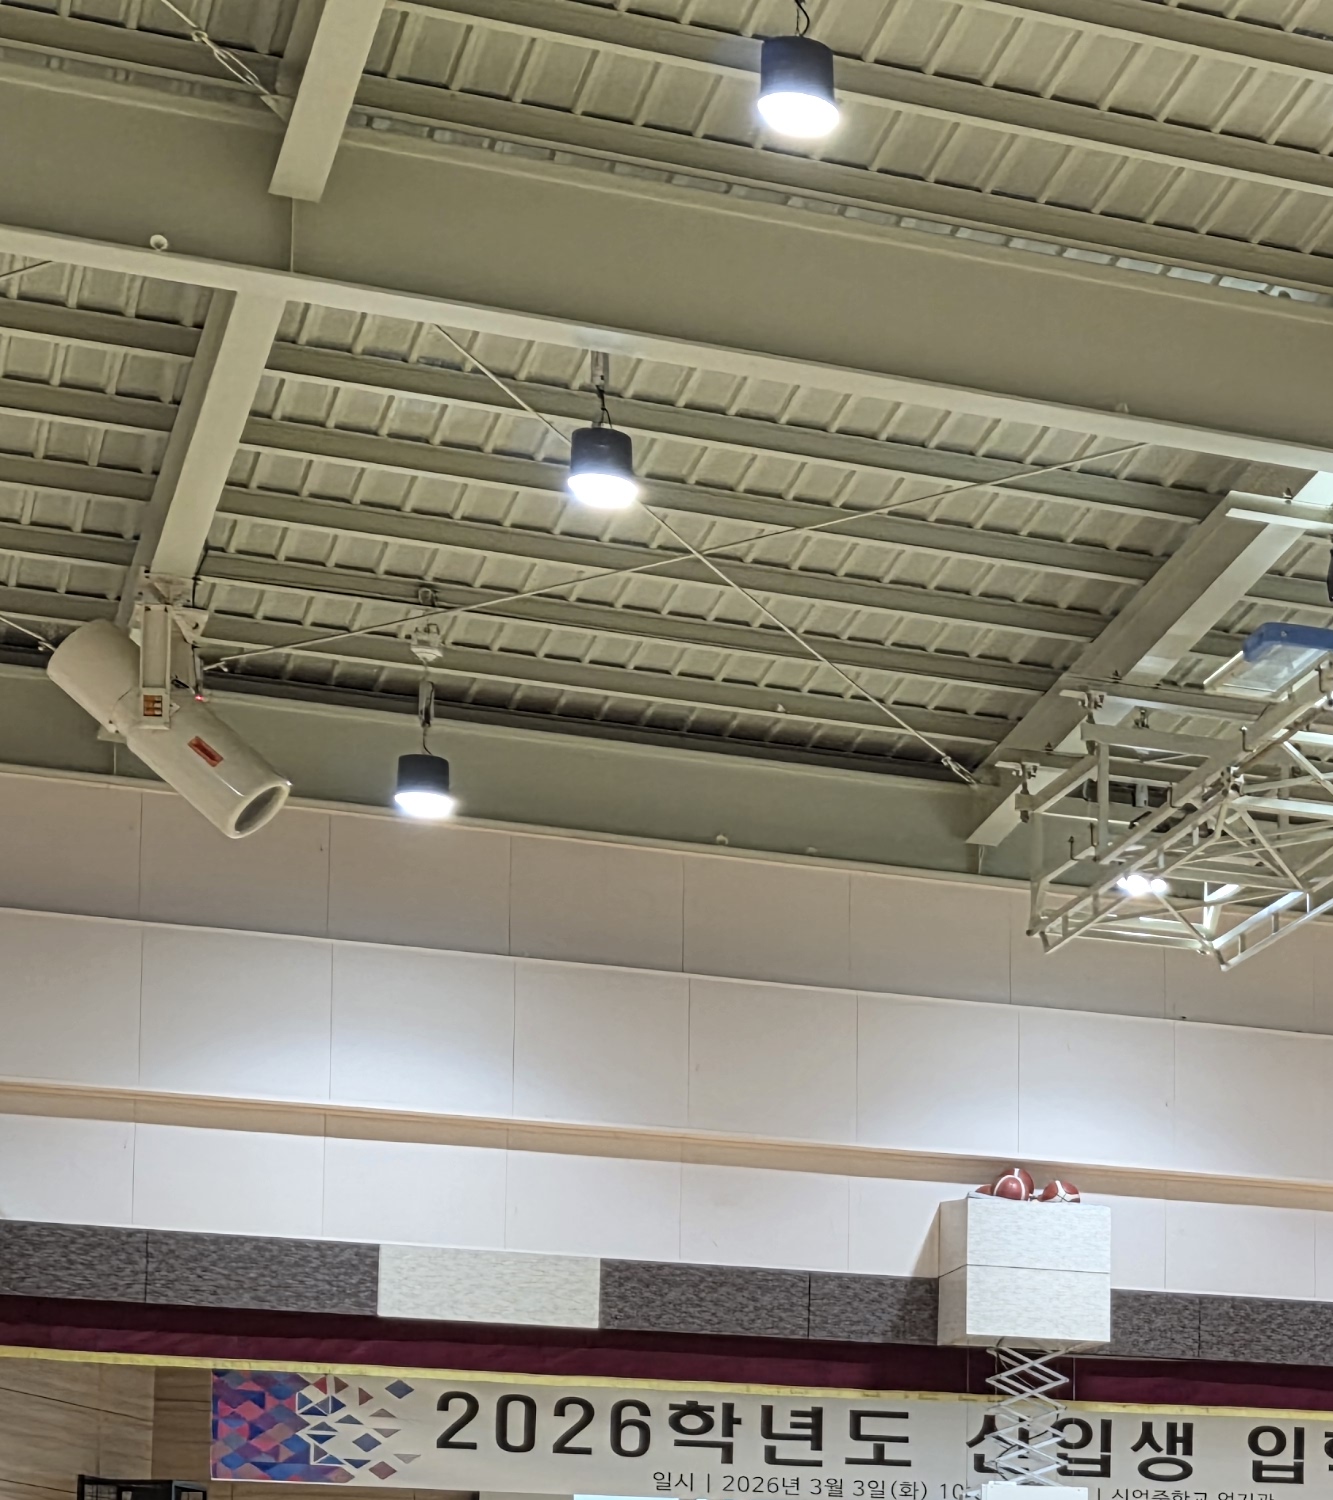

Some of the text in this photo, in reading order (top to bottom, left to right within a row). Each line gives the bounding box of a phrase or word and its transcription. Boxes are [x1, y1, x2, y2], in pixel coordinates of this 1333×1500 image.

[436, 1390, 913, 1468] 2026학년도
[653, 1472, 694, 1492] 일시
[722, 1475, 801, 1496] 2026년
[810, 1478, 844, 1498] 3월
[853, 1479, 928, 1500] 3일(화)
